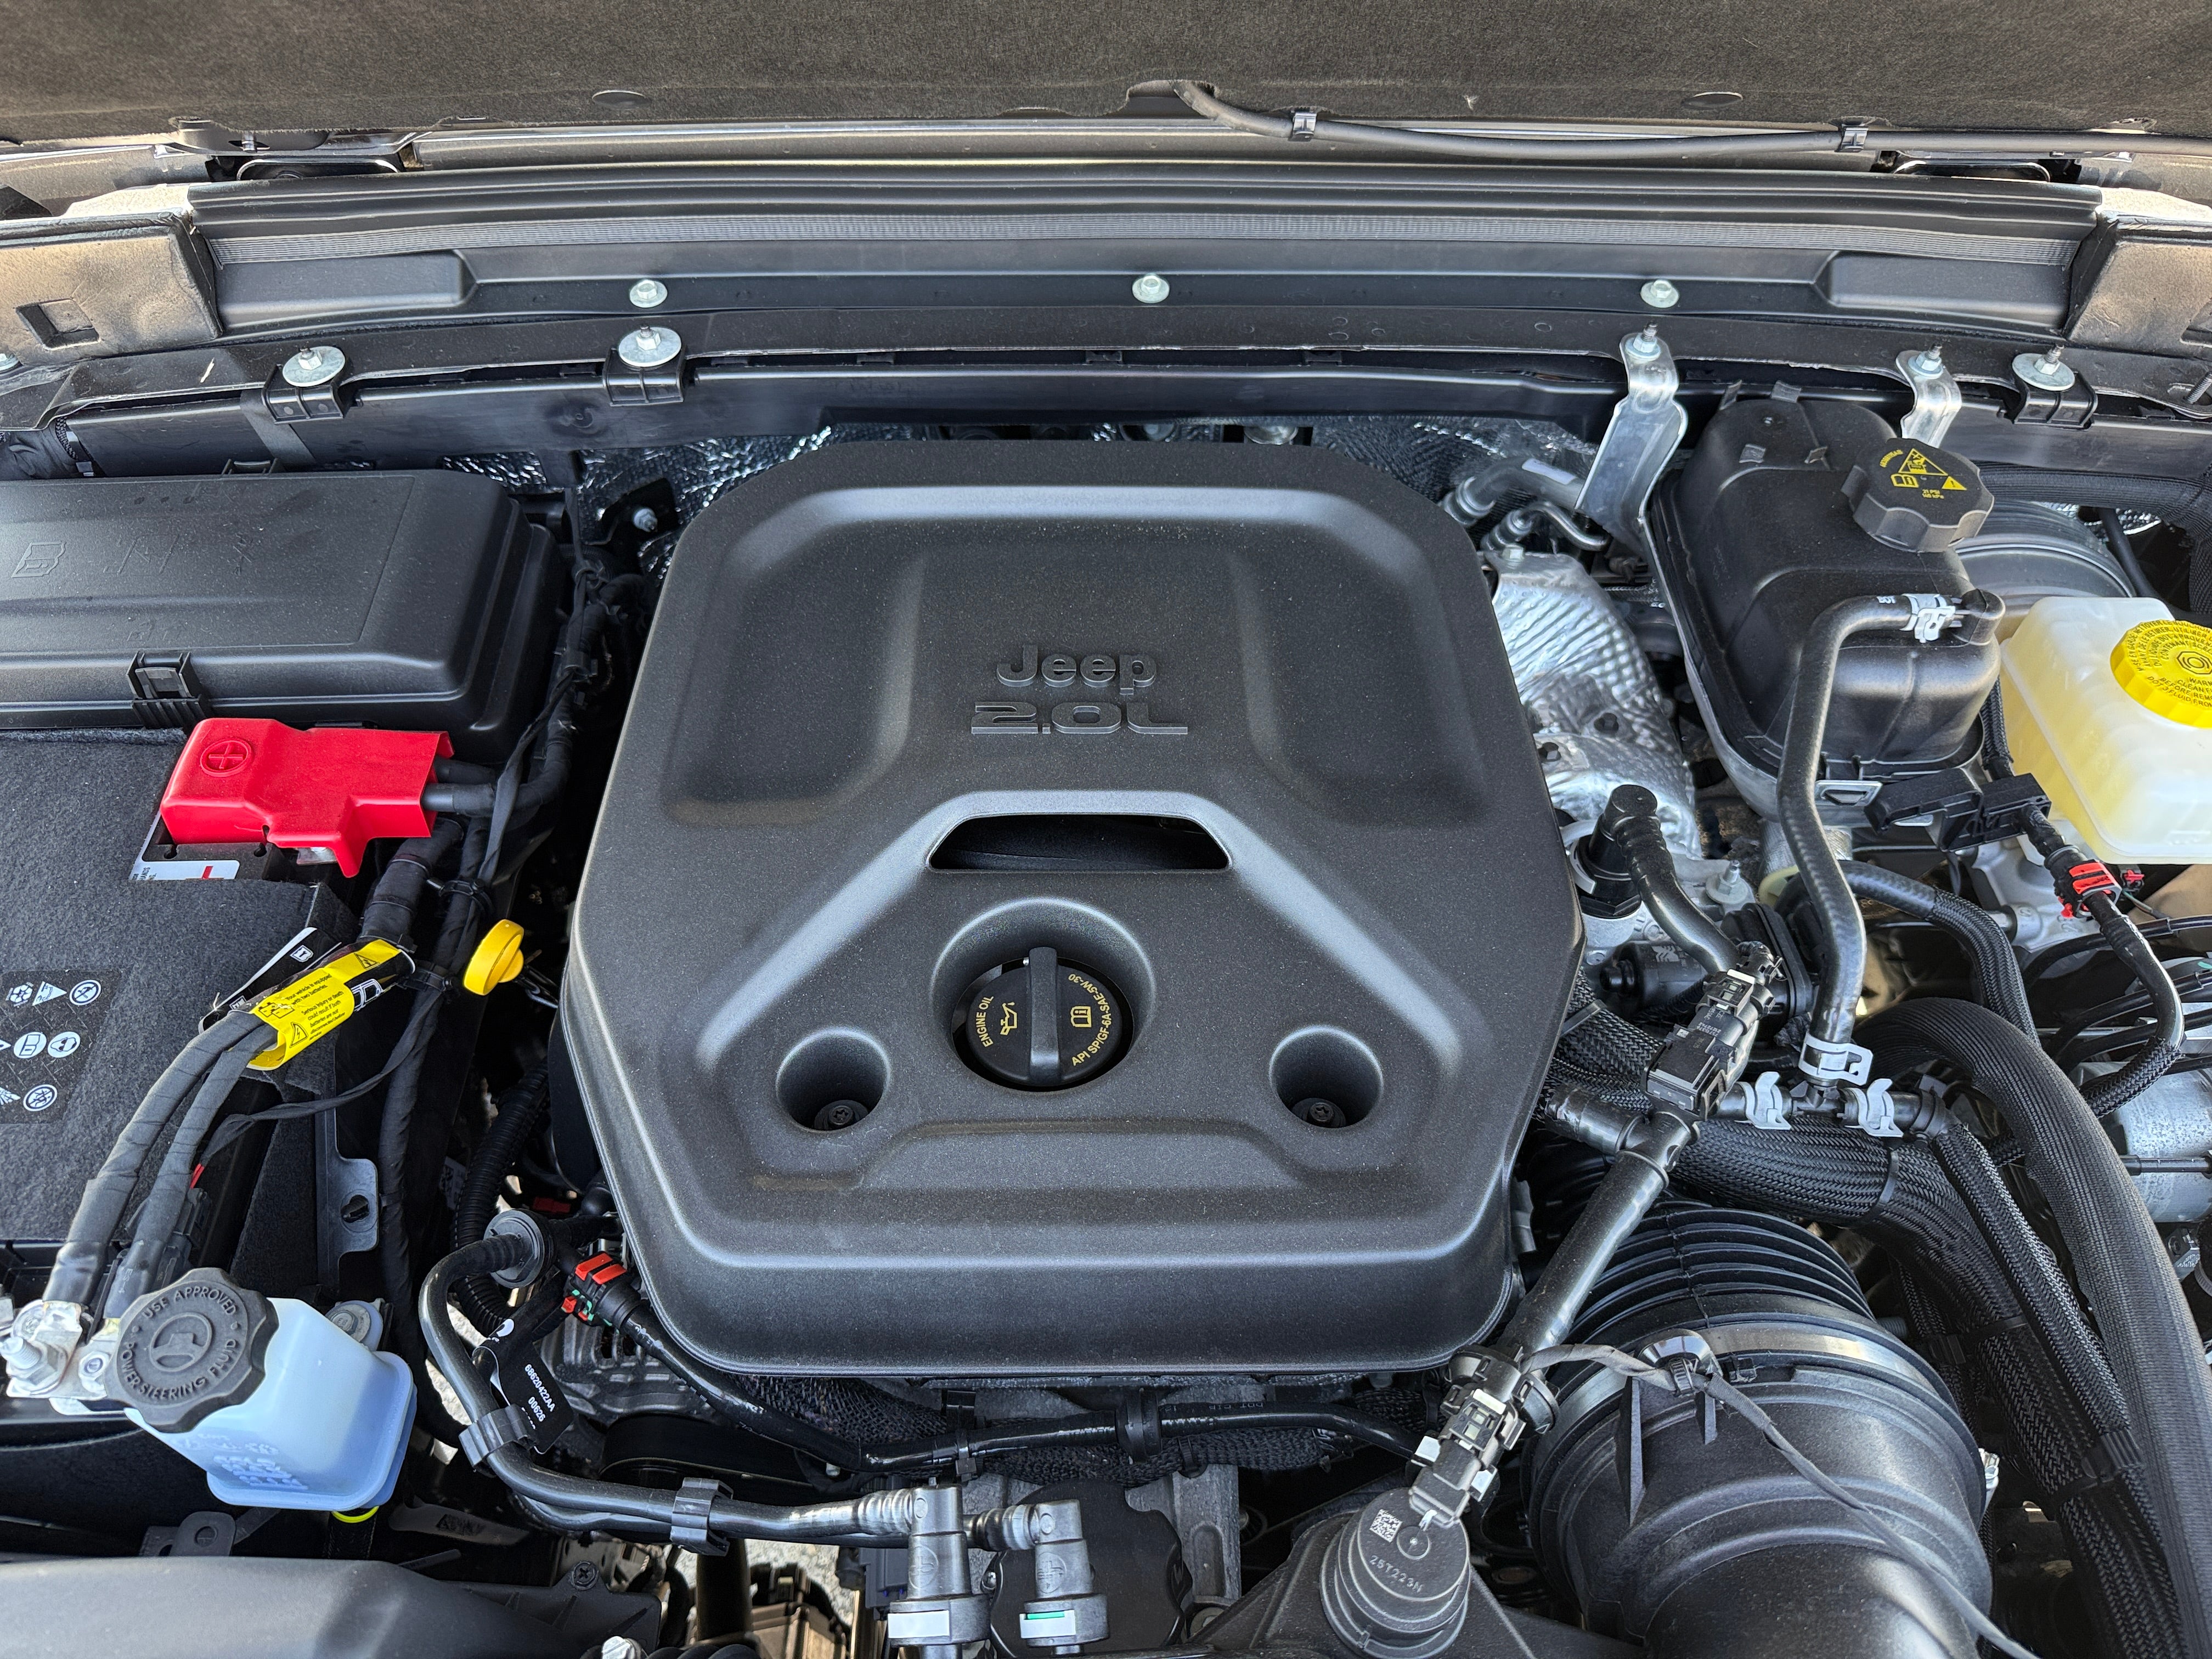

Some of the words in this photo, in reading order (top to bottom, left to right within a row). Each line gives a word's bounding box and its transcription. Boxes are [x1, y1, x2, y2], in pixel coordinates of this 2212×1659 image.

[996, 644, 1157, 696] Jeep
[2137, 650, 2152, 667] AVANT
[2150, 658, 2163, 667] DU
[2147, 676, 2164, 687] DOT
[2168, 689, 2191, 702] FLUID
[2159, 677, 2191, 696] BEFORE
[2177, 679, 2204, 693] CLEAN
[970, 701, 1189, 735] 2.0L
[295, 986, 311, 995] vehicle
[313, 973, 332, 985] equipped
[301, 1005, 318, 1015] Serious
[315, 999, 329, 1008] injury
[332, 991, 345, 999] death
[308, 1011, 319, 1021] could
[318, 1006, 329, 1015] result
[331, 1000, 341, 1008] both
[979, 995, 994, 1011] OIL
[1068, 973, 1112, 1054] SP/GF-6A-SAE-5W-30
[309, 1017, 326, 1028] batteries
[975, 1011, 994, 1048] ENGINE
[1071, 1051, 1091, 1066] API
[142, 1296, 169, 1319] USE
[173, 1284, 238, 1316] APPROVED
[121, 1341, 142, 1389] POWER
[138, 1375, 209, 1402] STEERING
[207, 1339, 238, 1378] FLUID
[524, 1364, 556, 1413] 68620422AA
[528, 1396, 546, 1423] 00626
